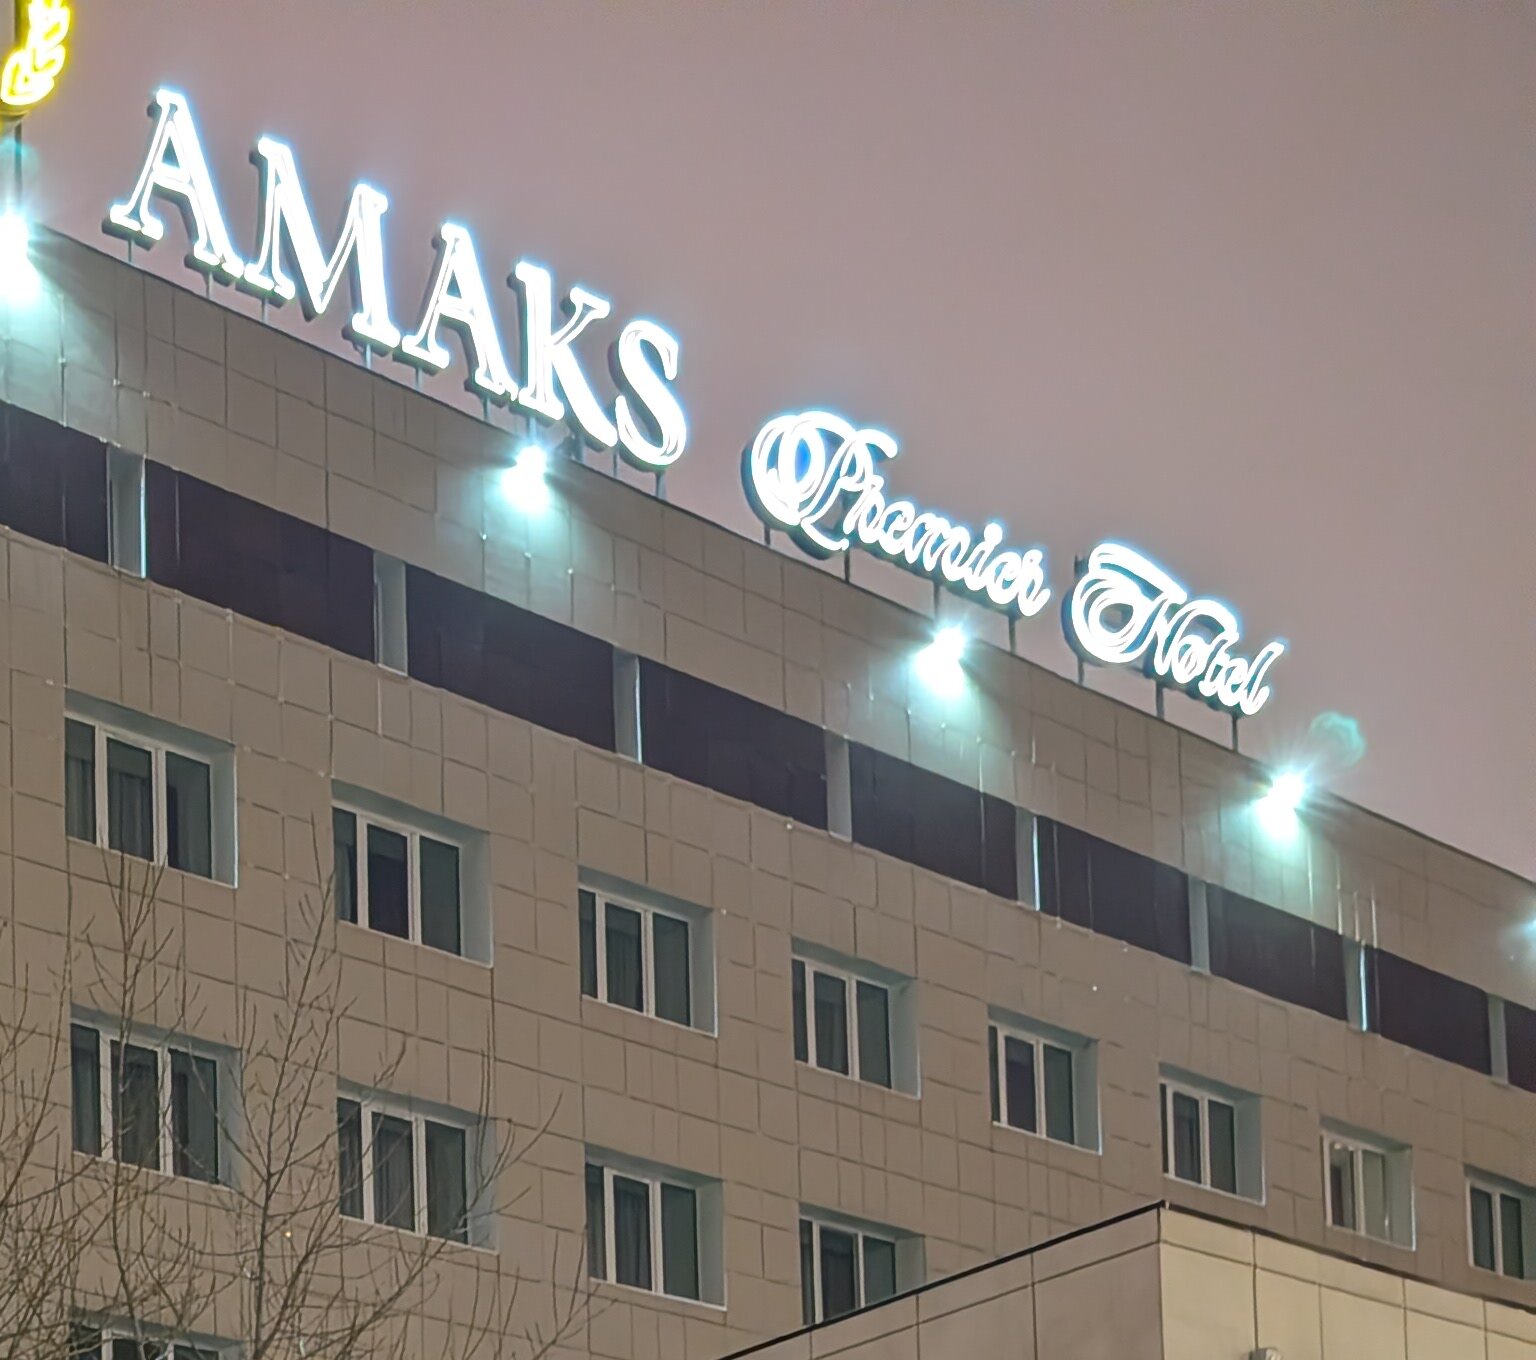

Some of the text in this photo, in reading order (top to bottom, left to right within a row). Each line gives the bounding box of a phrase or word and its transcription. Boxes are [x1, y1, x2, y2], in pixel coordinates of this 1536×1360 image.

[108, 86, 1286, 716] AMAKS Premier Hotel
